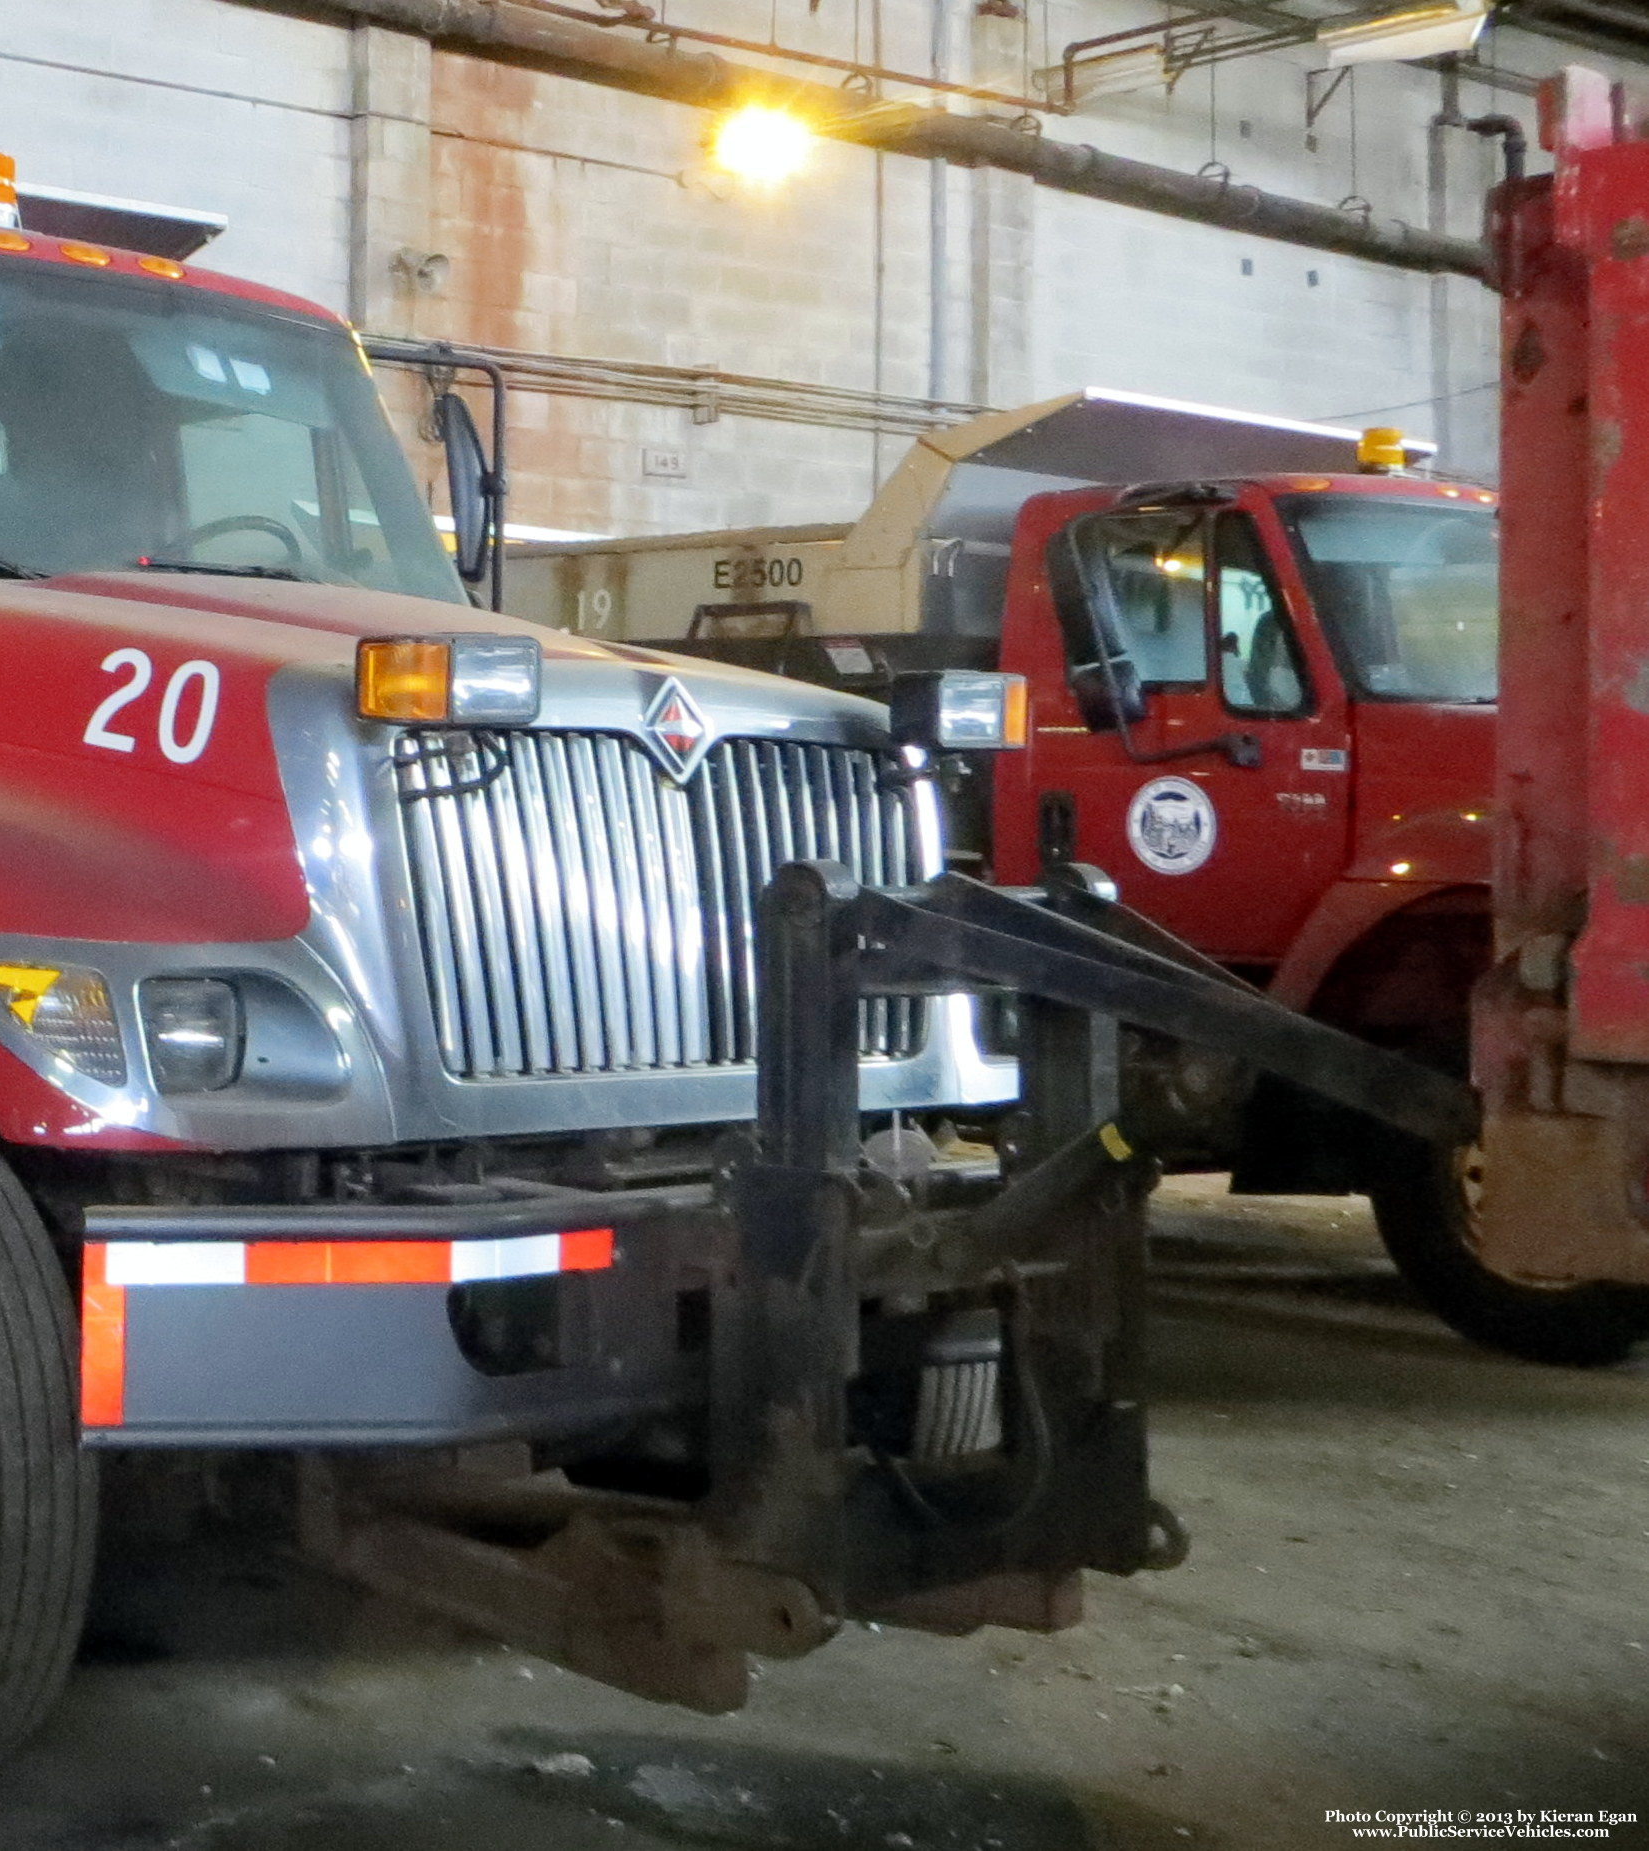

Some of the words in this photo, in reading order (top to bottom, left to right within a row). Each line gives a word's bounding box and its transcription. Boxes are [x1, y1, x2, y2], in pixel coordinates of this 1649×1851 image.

[714, 557, 803, 588] E2500
[577, 588, 612, 630] 19
[82, 647, 221, 765] 20
